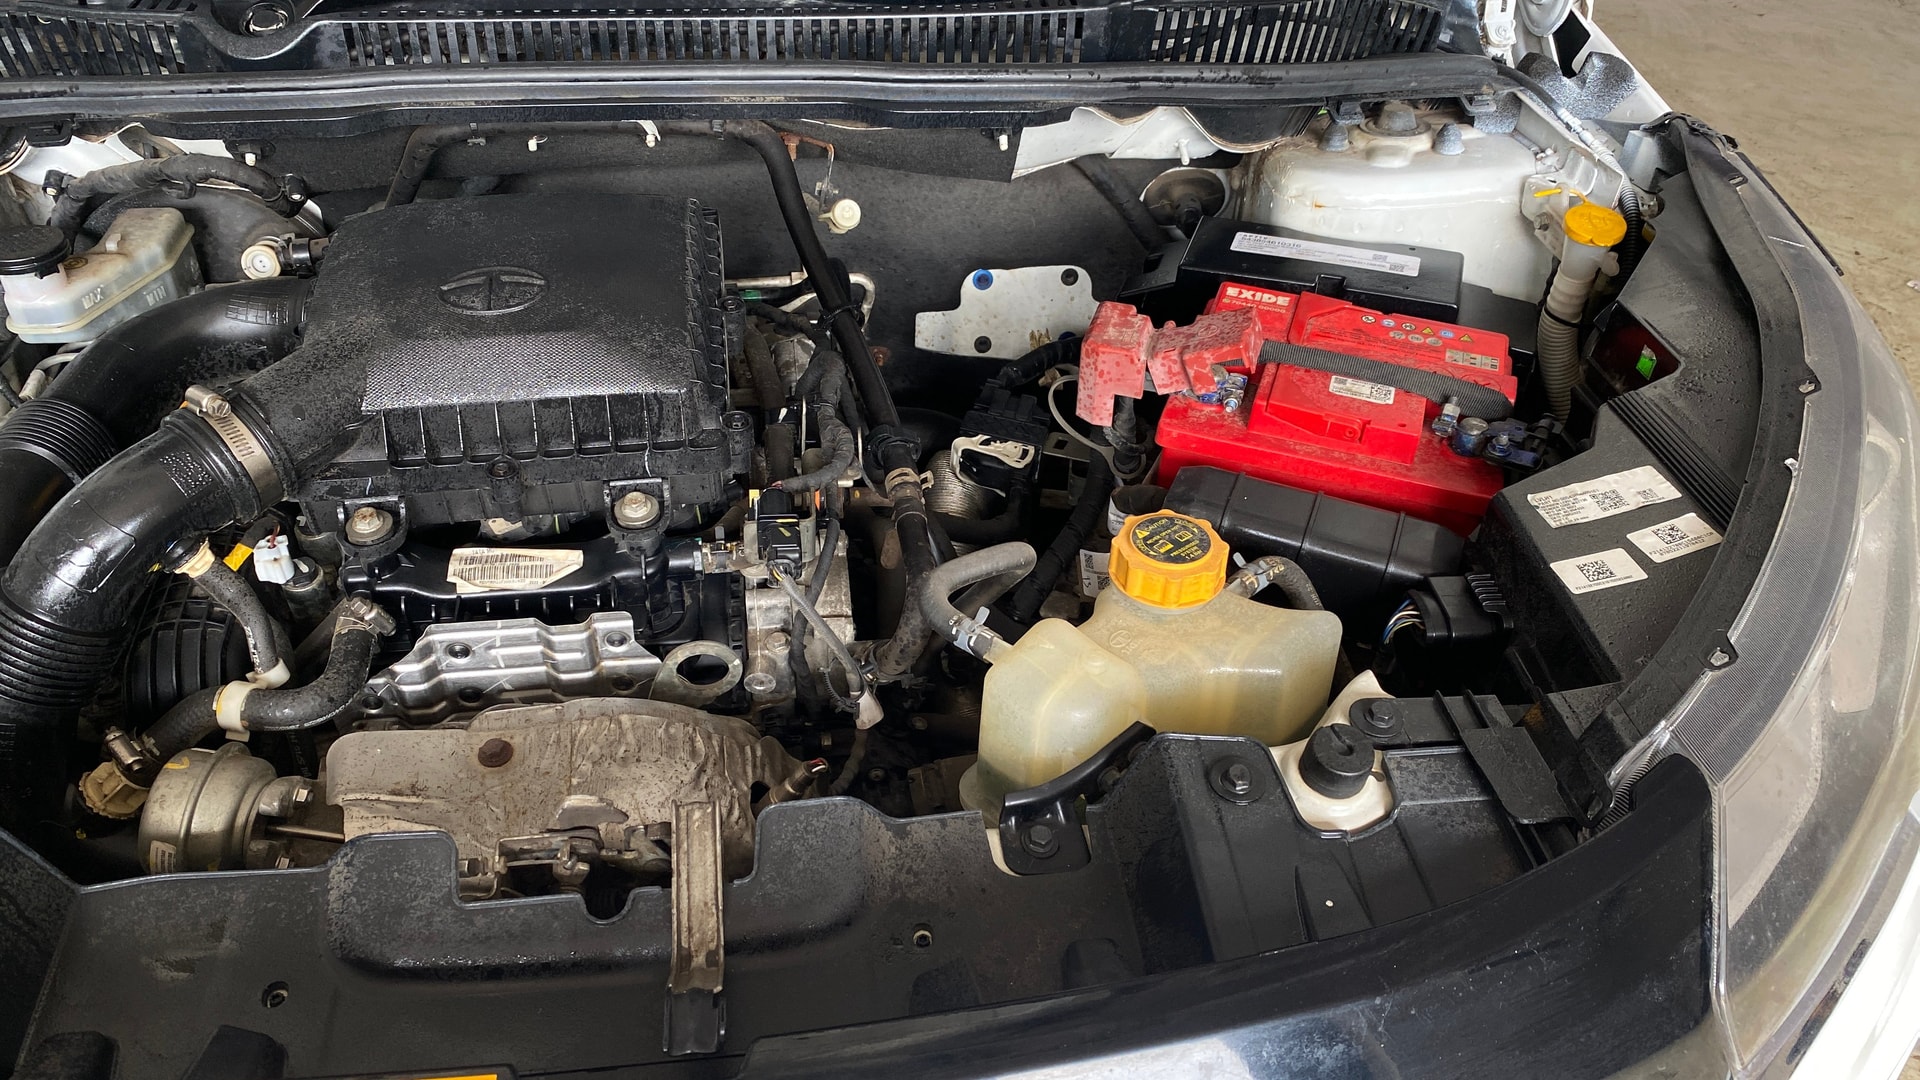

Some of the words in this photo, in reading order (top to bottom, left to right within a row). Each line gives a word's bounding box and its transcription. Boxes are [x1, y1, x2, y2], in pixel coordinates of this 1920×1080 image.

[82, 287, 104, 309] MAX
[146, 285, 166, 306] MIN
[1226, 286, 1291, 306] EXIDE
[1144, 518, 1169, 532] CAUTION
